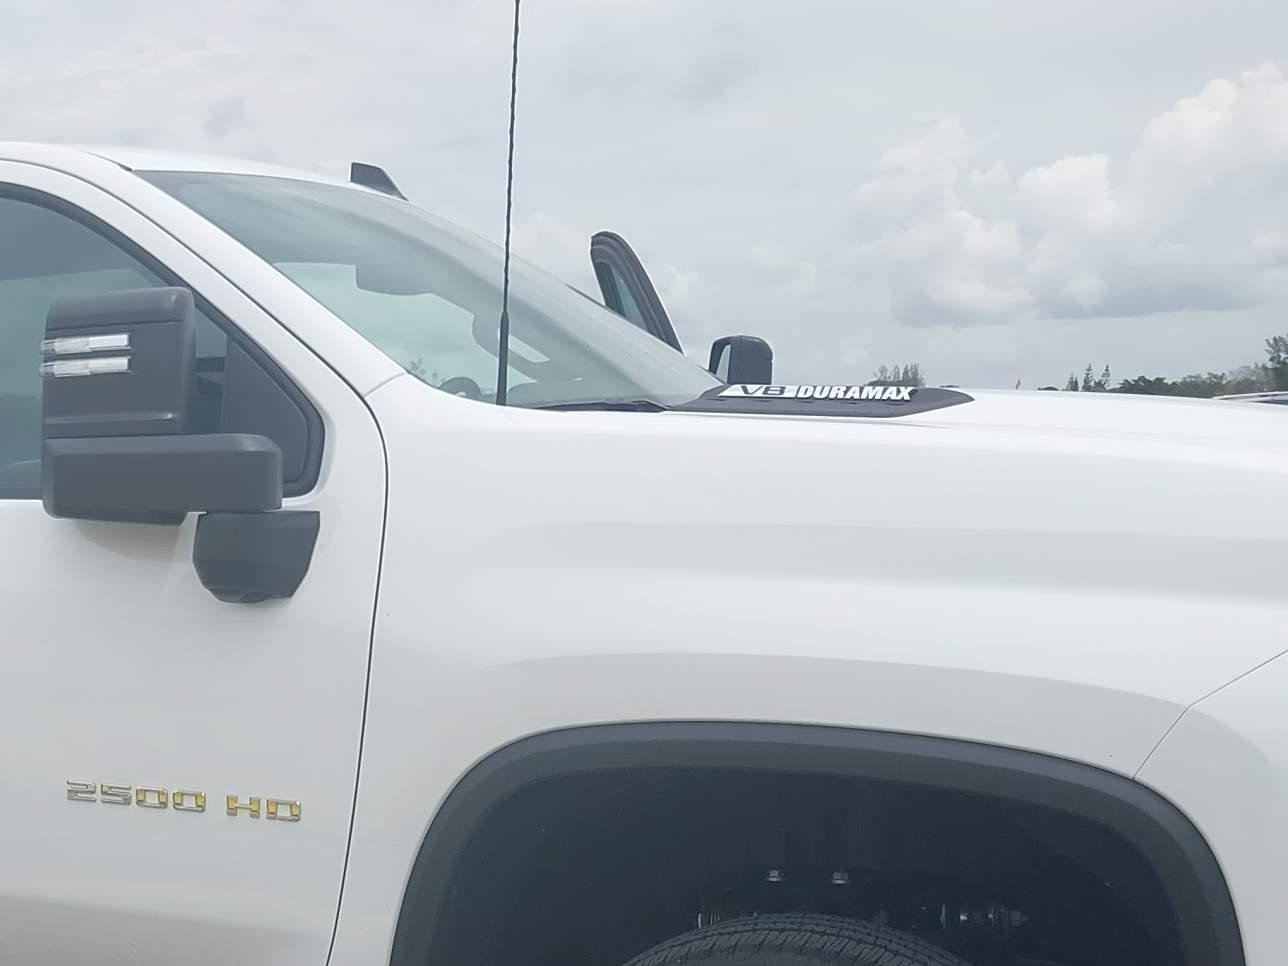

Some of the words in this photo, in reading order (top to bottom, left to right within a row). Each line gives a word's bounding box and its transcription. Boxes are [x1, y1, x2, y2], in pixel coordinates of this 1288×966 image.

[738, 384, 788, 397] V8
[797, 385, 913, 401] DURAMAX
[66, 779, 206, 812] 2500
[226, 793, 302, 822] HD
